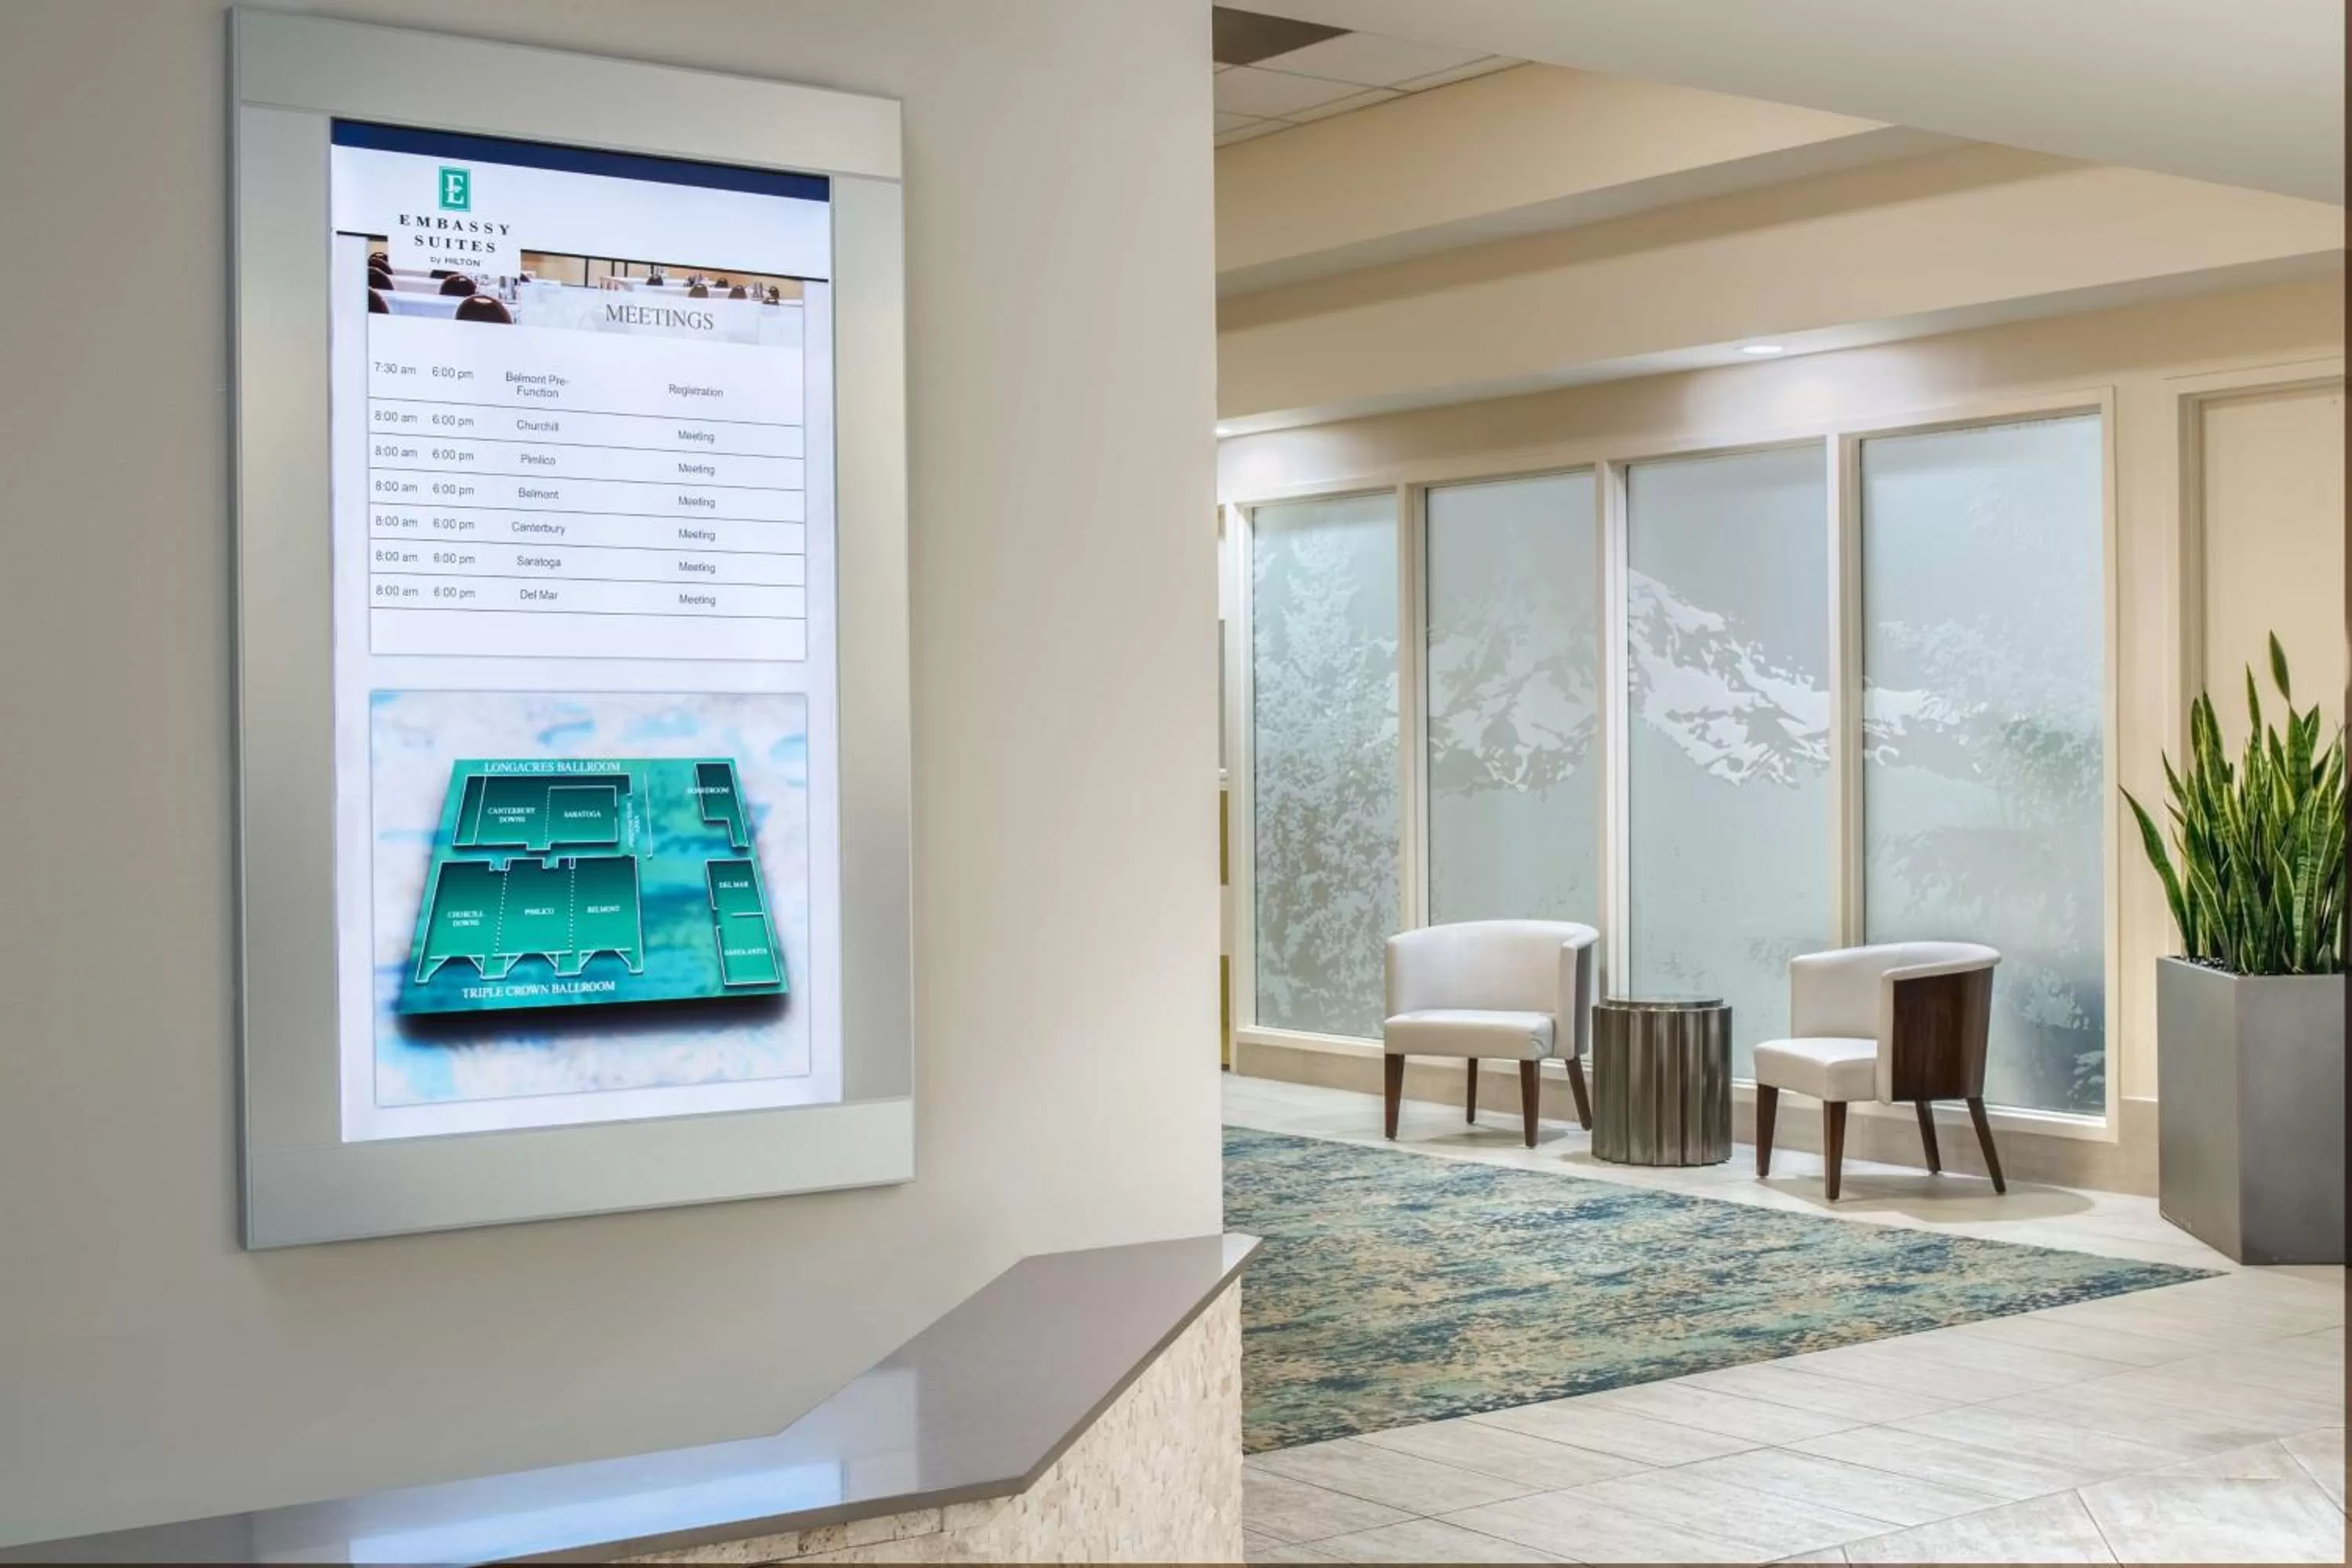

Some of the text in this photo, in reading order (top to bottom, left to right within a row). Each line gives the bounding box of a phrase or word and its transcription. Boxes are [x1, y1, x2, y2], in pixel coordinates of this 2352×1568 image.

[399, 214, 510, 236] EMBASSY
[414, 234, 496, 253] SUITES
[445, 256, 481, 267] HILTON
[605, 303, 714, 331] MEETINGS
[374, 361, 416, 375] 7:30 am
[432, 366, 474, 381] 6:00 pm
[505, 371, 569, 387] Belmont Pre-
[517, 385, 559, 398] Function
[669, 383, 724, 397] Registration
[374, 410, 418, 423] 8:00 am
[431, 413, 474, 427] 6:00 pm
[516, 419, 559, 432] Churchill
[677, 430, 716, 445] Meeting
[375, 445, 418, 458] 8:00 am
[432, 448, 474, 462] 6:00 pm
[520, 453, 557, 466] Pimlico
[678, 463, 716, 477] Meeting
[376, 479, 418, 493] 8:00 am
[432, 483, 474, 497] 6:00 pm
[518, 487, 559, 499] Belmont
[678, 495, 716, 509] Meeting
[376, 515, 418, 528] 8:00 am
[433, 517, 474, 532] 6:00 pm
[511, 521, 565, 536] Canterbury
[678, 528, 716, 542] Meeting
[376, 550, 418, 562] 8:00 am
[433, 553, 476, 565] 6:00 pm
[517, 554, 562, 570] Saratoga
[678, 561, 716, 575] Meeting
[376, 585, 398, 597] 8:00
[434, 586, 476, 600] 6:00 pm
[520, 589, 558, 601] Del Mar
[679, 593, 716, 608] Meeting
[485, 762, 621, 772] LONGACRES BALLROOM
[524, 907, 554, 916] PIMLICO
[587, 905, 621, 913] BELMONT
[462, 981, 615, 999] TRIPLE CROWN BALLROOM
